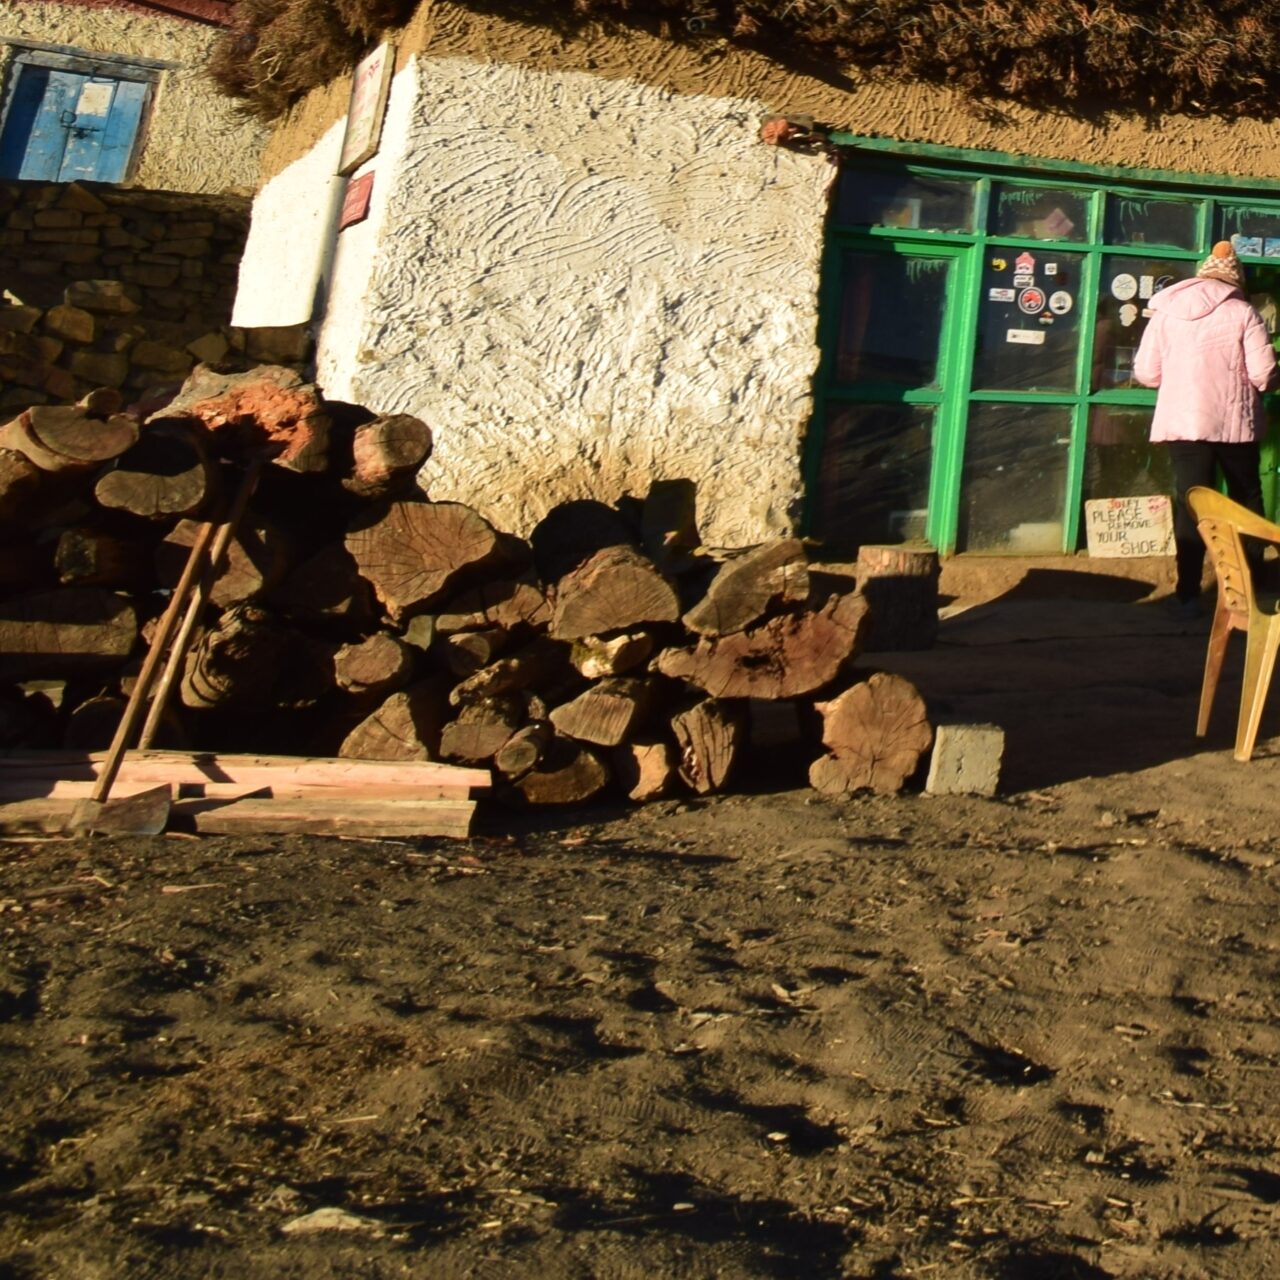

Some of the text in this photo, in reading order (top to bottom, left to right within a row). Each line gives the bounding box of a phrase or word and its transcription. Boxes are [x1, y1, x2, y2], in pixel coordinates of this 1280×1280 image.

[1093, 508, 1142, 524] PLEASE
[1108, 520, 1152, 530] REMOVE
[1097, 531, 1127, 543] YOUR
[1121, 540, 1158, 555] SHOE
